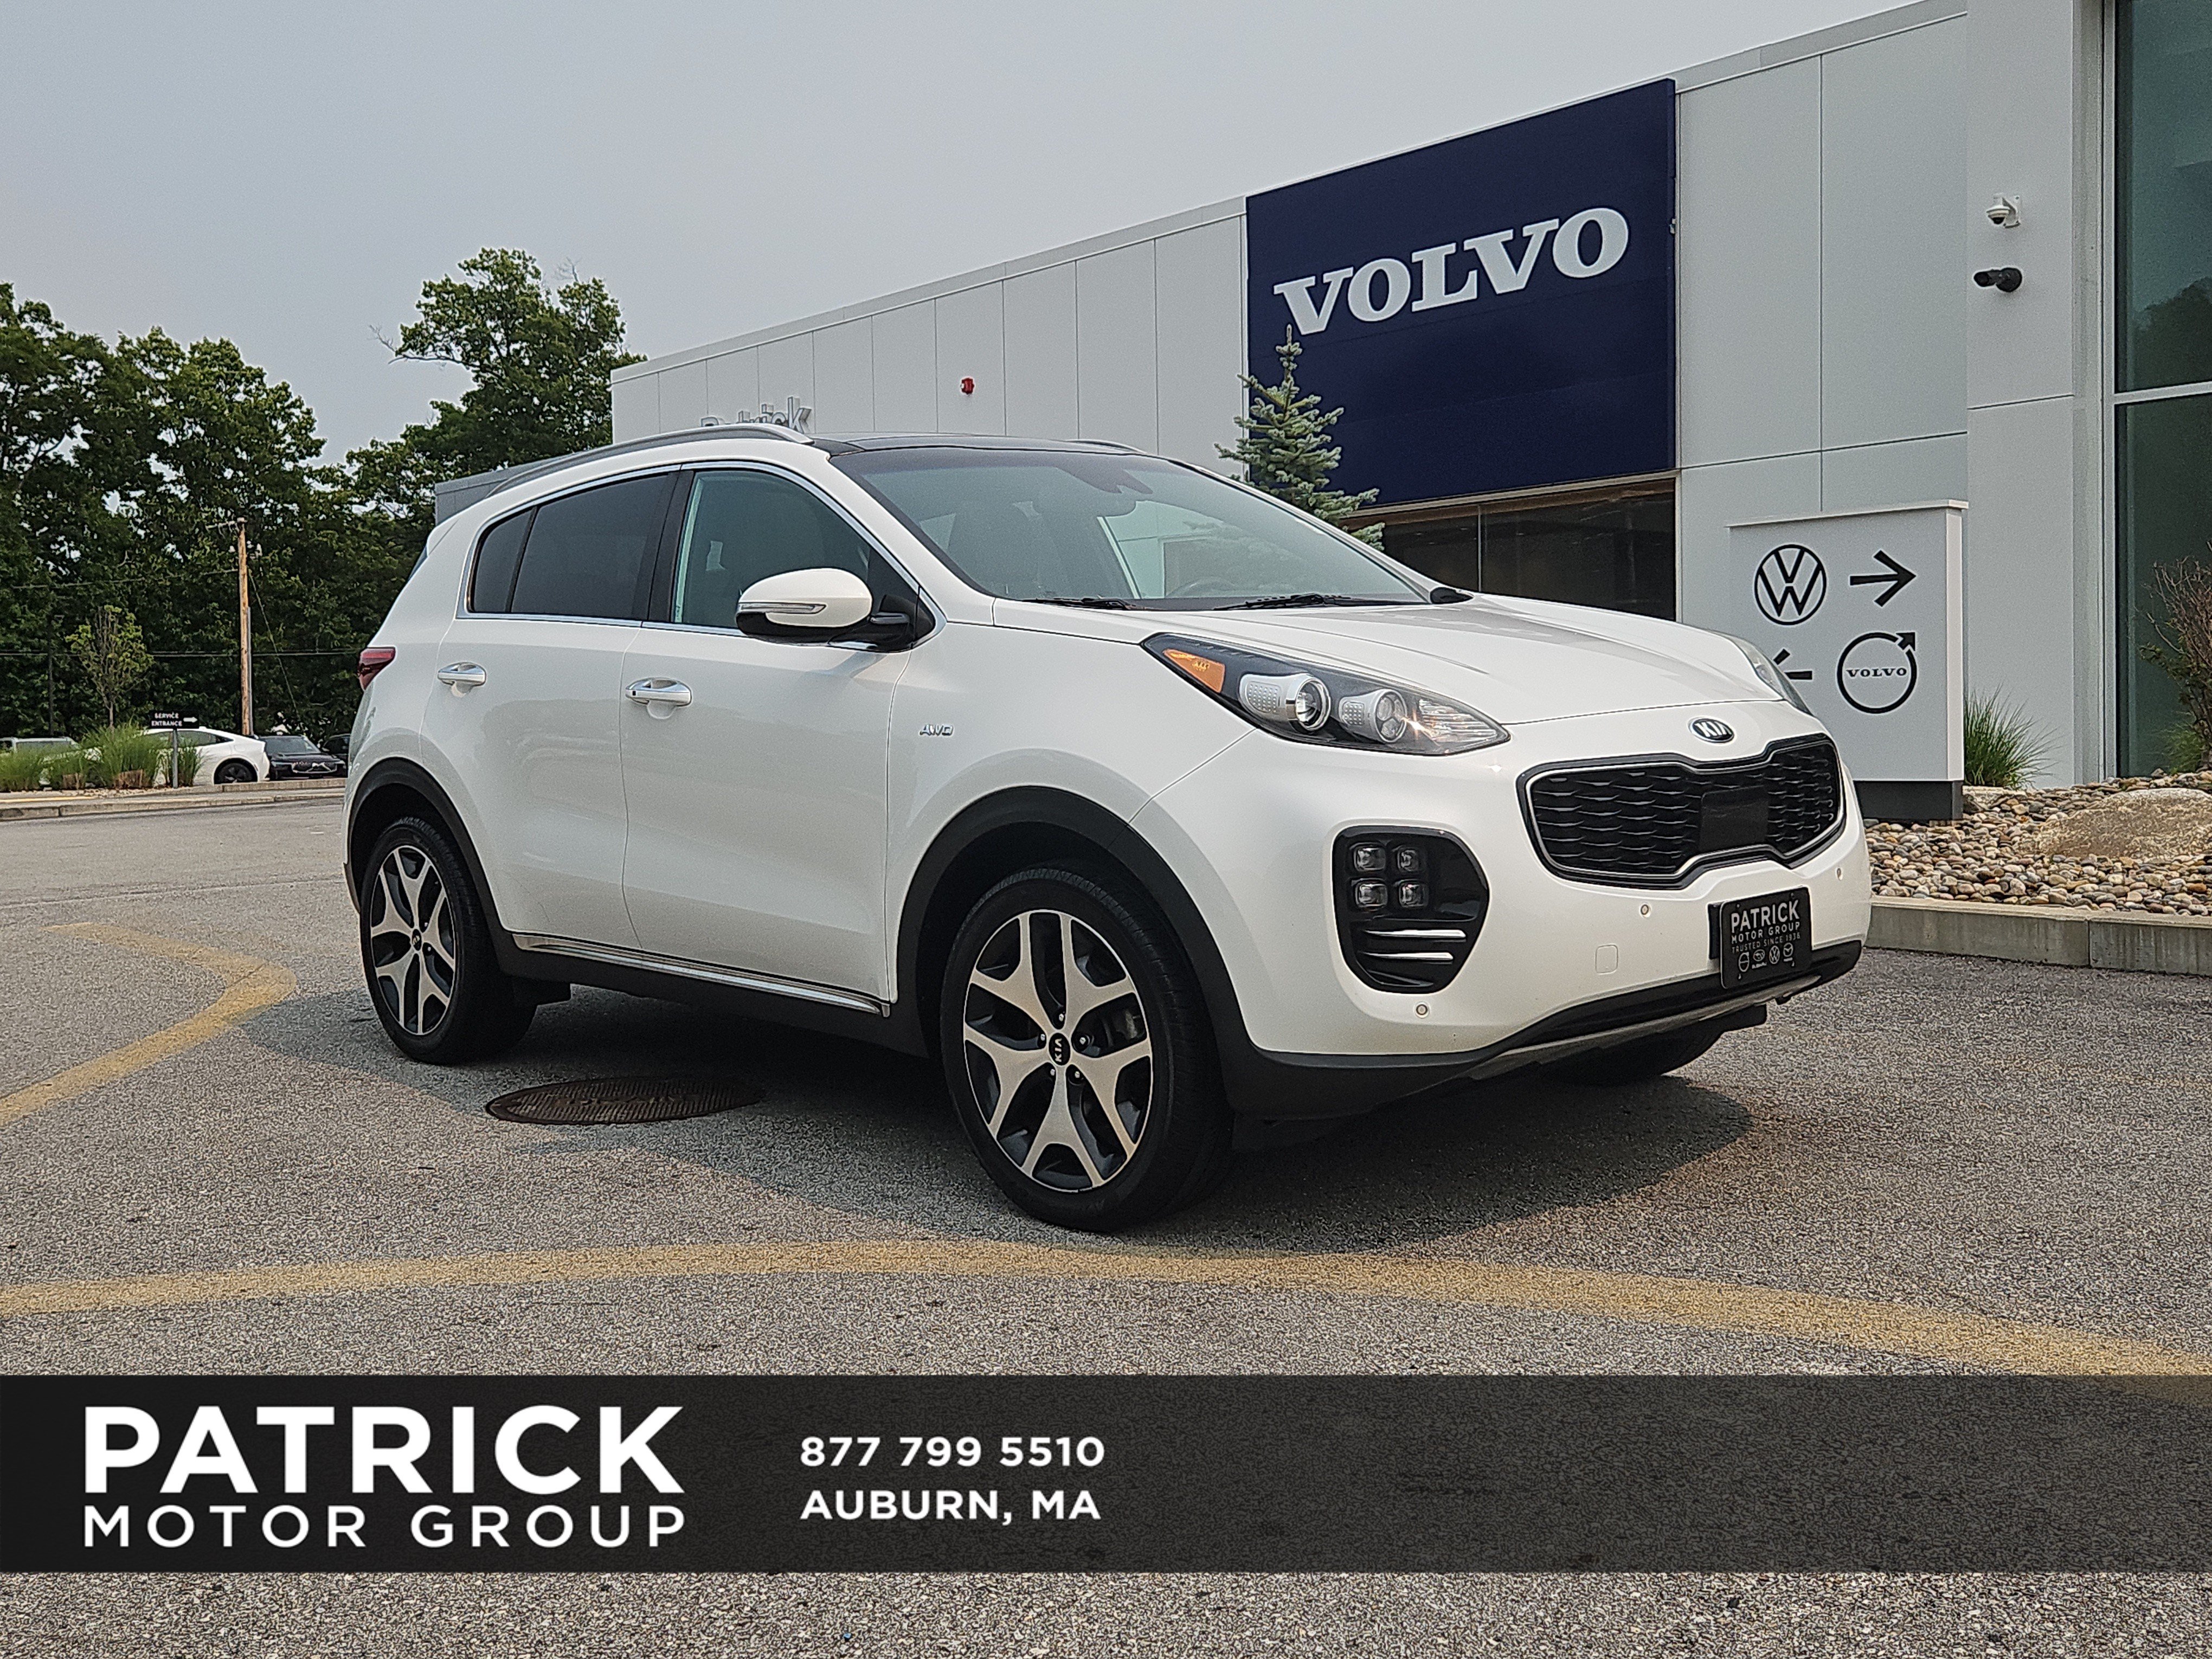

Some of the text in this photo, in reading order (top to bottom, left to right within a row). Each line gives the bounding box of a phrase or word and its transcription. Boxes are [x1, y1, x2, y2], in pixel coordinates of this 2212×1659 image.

[1274, 208, 1628, 335] VOLVO
[1846, 667, 1907, 677] VOLVO
[920, 724, 953, 736] AWD
[1694, 721, 1732, 737] KIA
[1731, 899, 1800, 933] PATRICK
[1731, 922, 1800, 944] MOTOR GROUP
[1732, 941, 1760, 954] TRUSTED
[1763, 936, 1783, 947] SINCE
